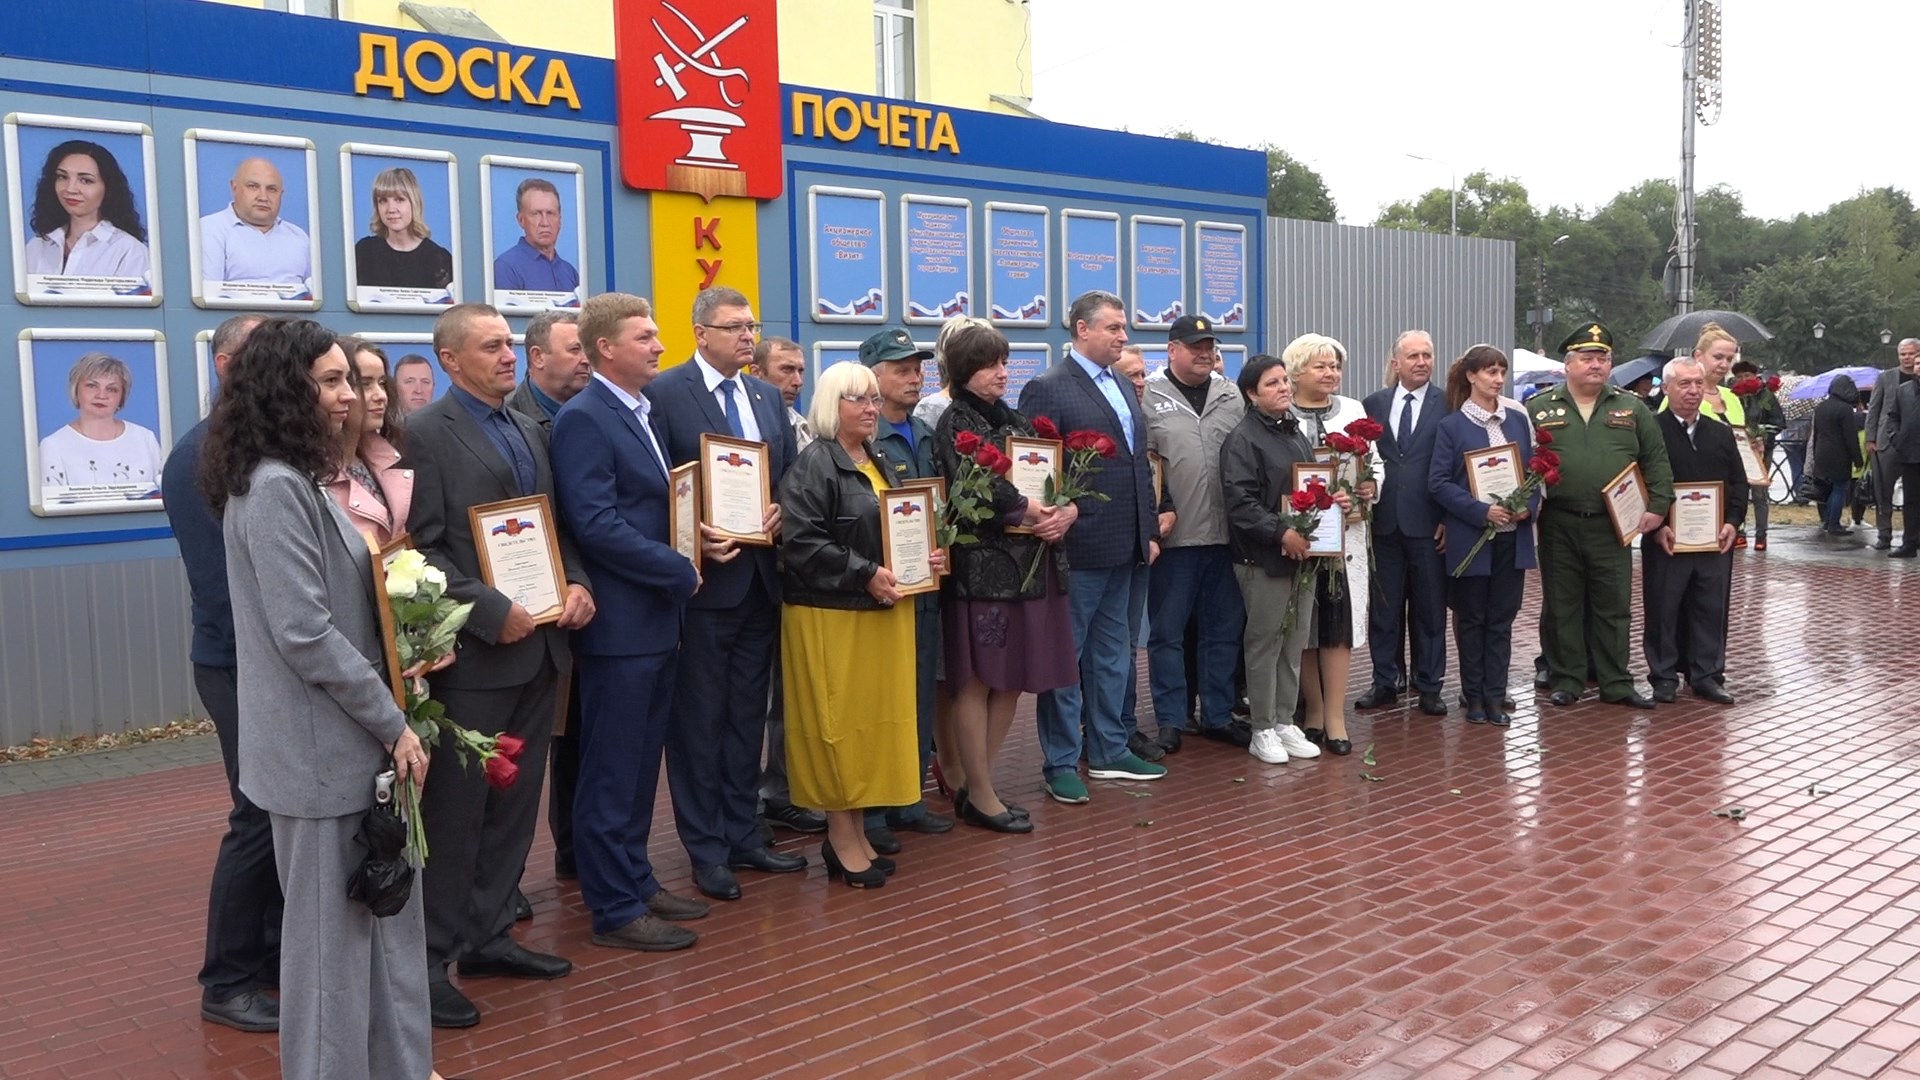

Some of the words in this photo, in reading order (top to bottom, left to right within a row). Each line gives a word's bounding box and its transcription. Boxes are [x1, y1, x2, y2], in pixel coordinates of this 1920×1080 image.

[355, 32, 582, 110] ДОСКА
[792, 91, 961, 155] ПОЧЕТА
[823, 224, 872, 237] Акционерное
[831, 239, 867, 248] общество
